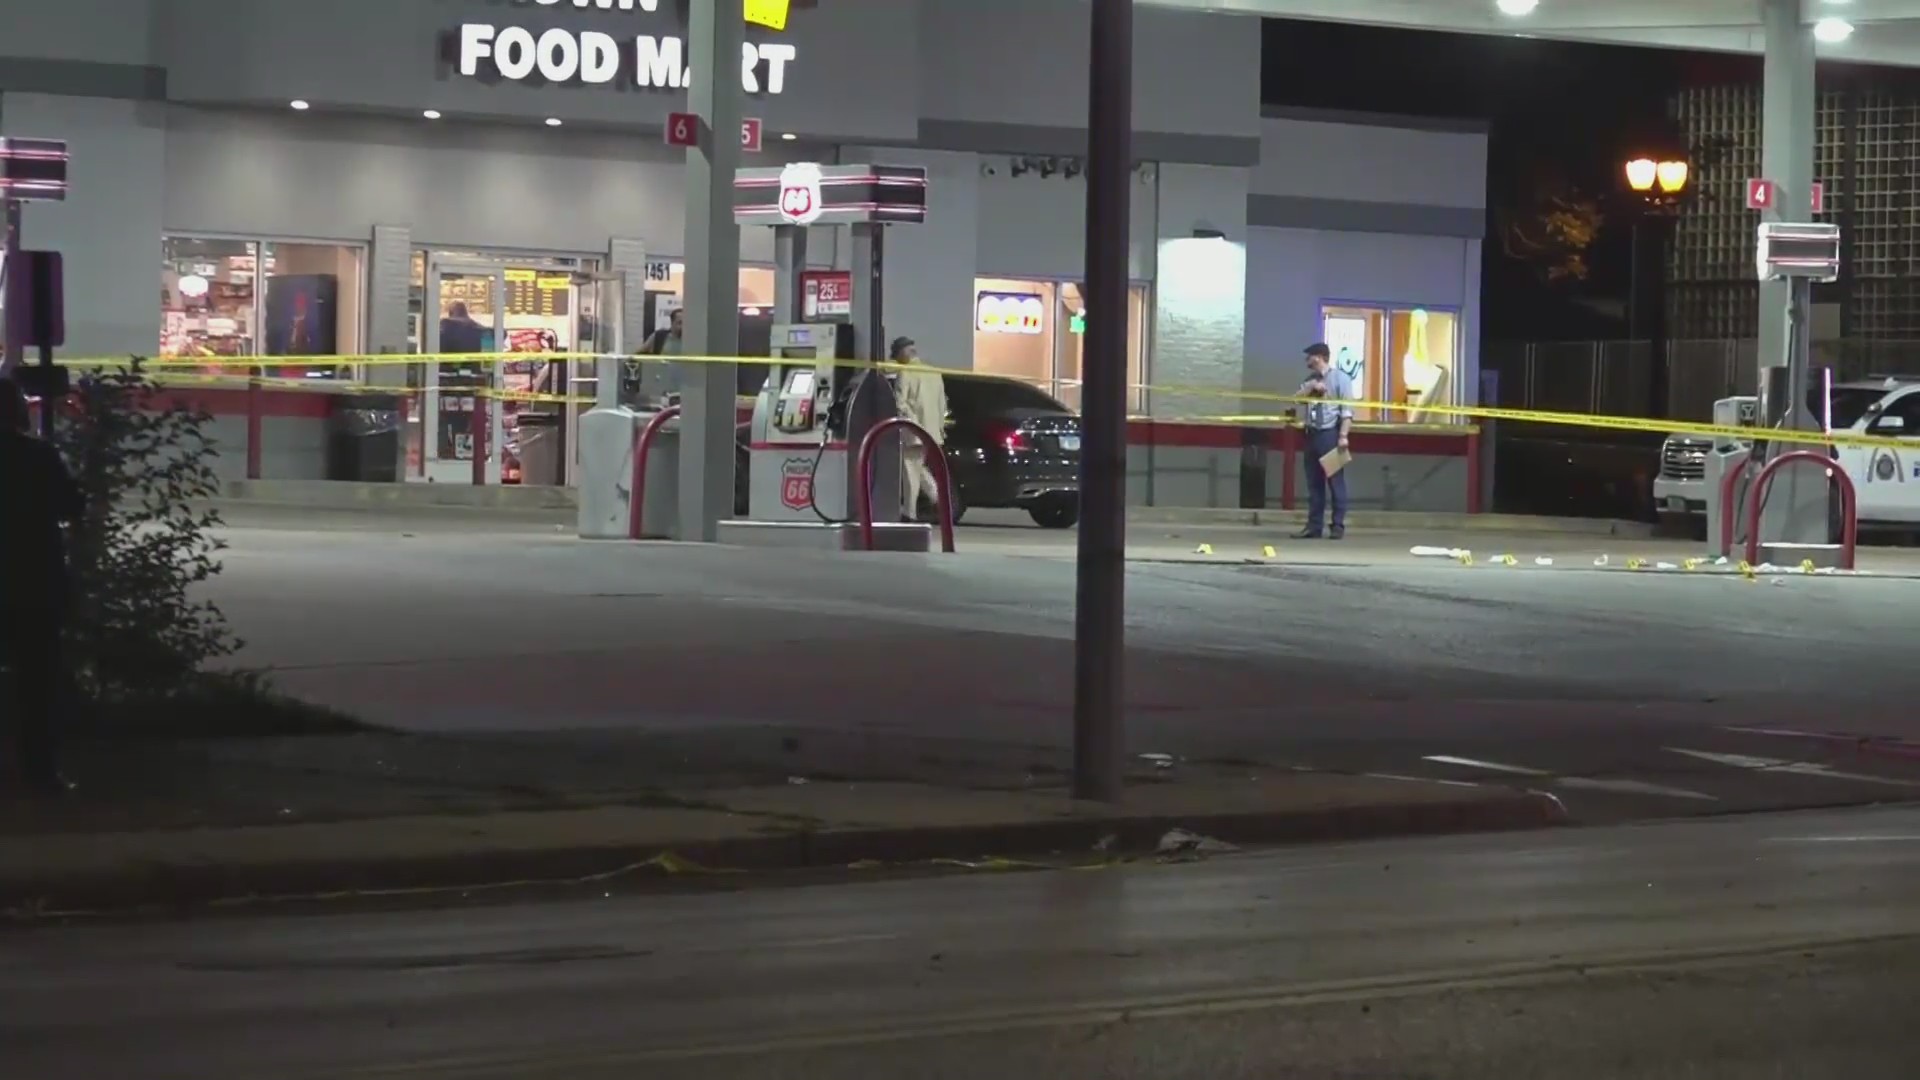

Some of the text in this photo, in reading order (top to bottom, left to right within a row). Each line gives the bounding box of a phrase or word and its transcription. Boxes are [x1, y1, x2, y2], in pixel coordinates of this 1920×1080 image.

[461, 23, 796, 94] FOOD MRT
[675, 119, 687, 139] 6
[741, 124, 751, 144] 5
[1755, 184, 1766, 203] 4
[645, 263, 670, 280] 1451
[787, 480, 809, 499] 66
